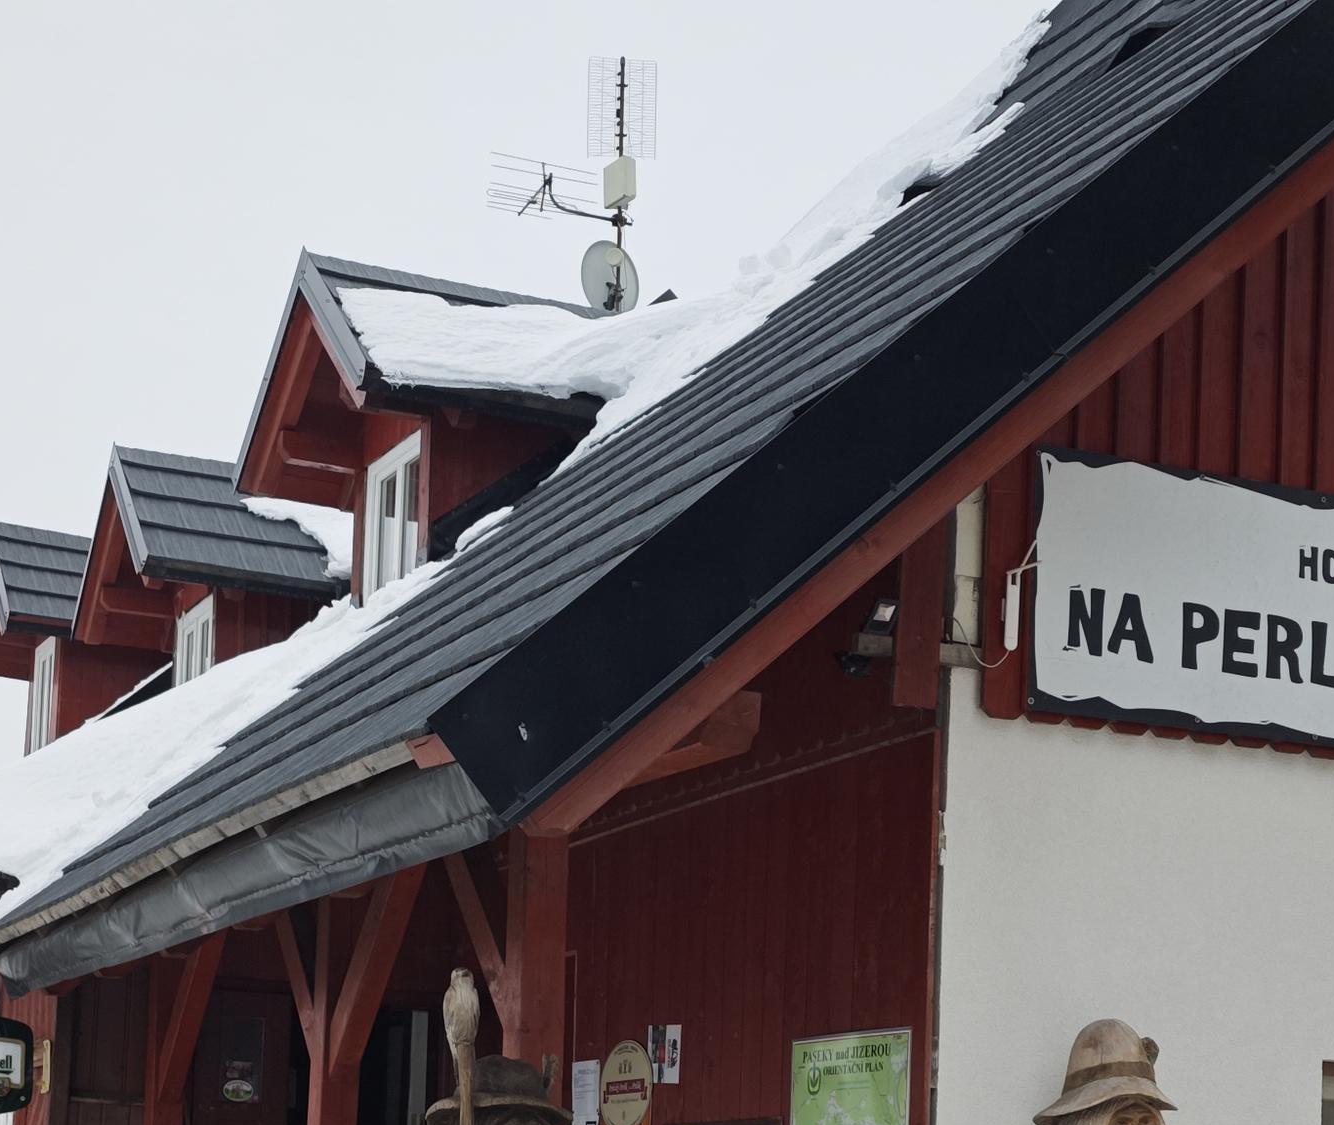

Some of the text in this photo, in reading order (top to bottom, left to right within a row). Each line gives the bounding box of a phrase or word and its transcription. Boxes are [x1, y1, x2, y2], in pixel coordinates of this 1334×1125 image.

[1066, 588, 1154, 664] NA
[802, 1043, 891, 1063] PASEKY nad JIZEROU
[823, 1061, 864, 1076] ORIENTAČNÍ
